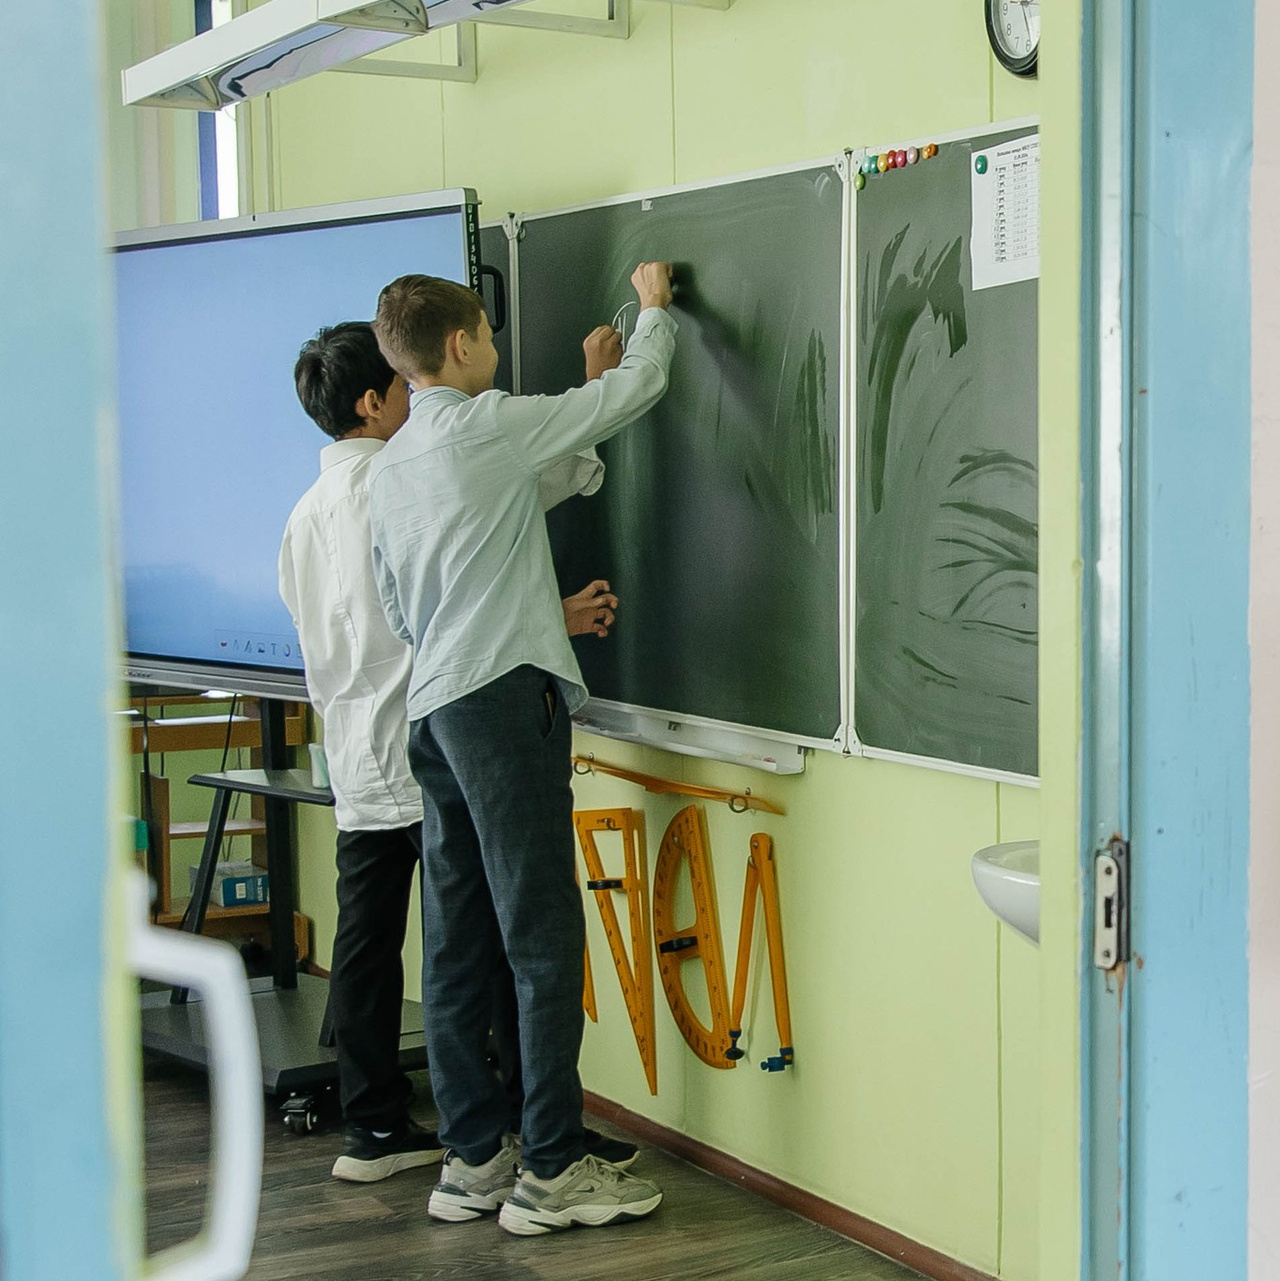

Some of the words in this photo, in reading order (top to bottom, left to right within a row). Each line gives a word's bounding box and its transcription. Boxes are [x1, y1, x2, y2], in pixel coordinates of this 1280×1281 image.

[1003, 2, 1008, 16] 9
[1006, 23, 1011, 36] 8
[1015, 36, 1020, 49] 7
[1025, 39, 1031, 52] 6
